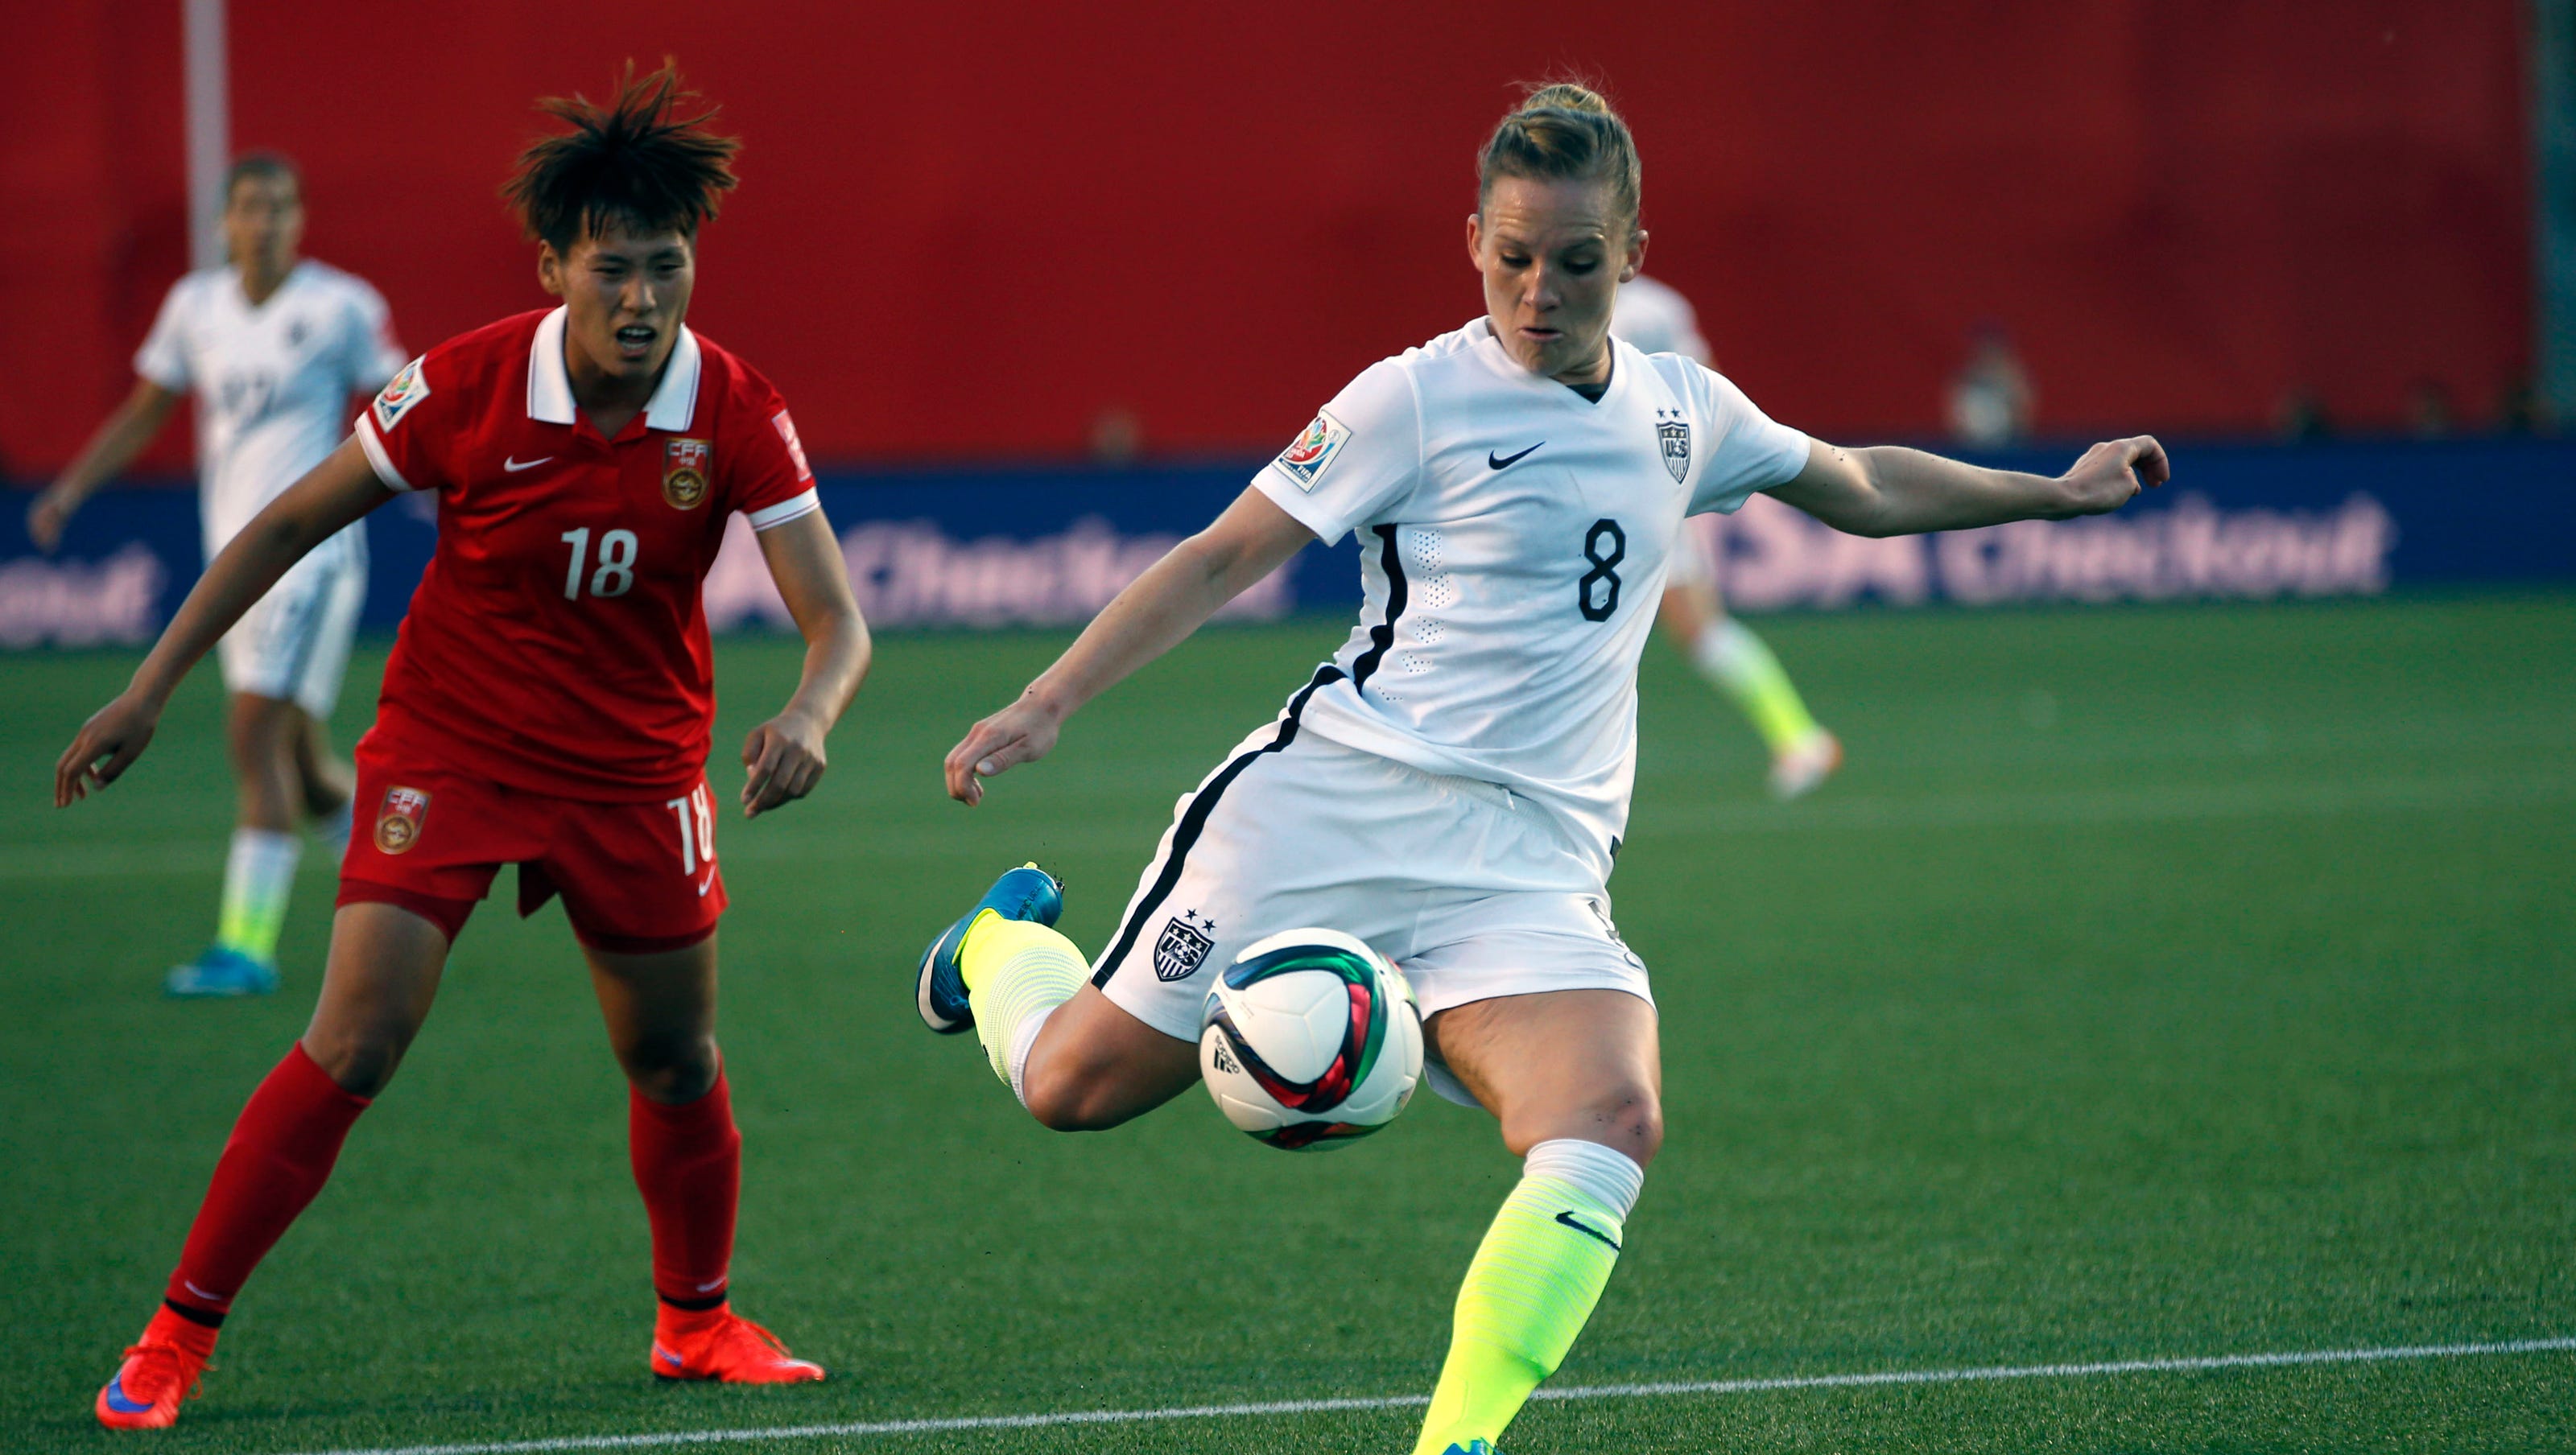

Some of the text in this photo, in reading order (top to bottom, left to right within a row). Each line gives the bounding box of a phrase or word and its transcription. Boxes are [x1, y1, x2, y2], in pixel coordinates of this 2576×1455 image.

[1297, 464, 1312, 480] FIFA
[561, 526, 638, 601] 18
[1579, 518, 1626, 622] 8
[667, 782, 713, 876] 18
[1215, 1035, 1241, 1074] adidas
